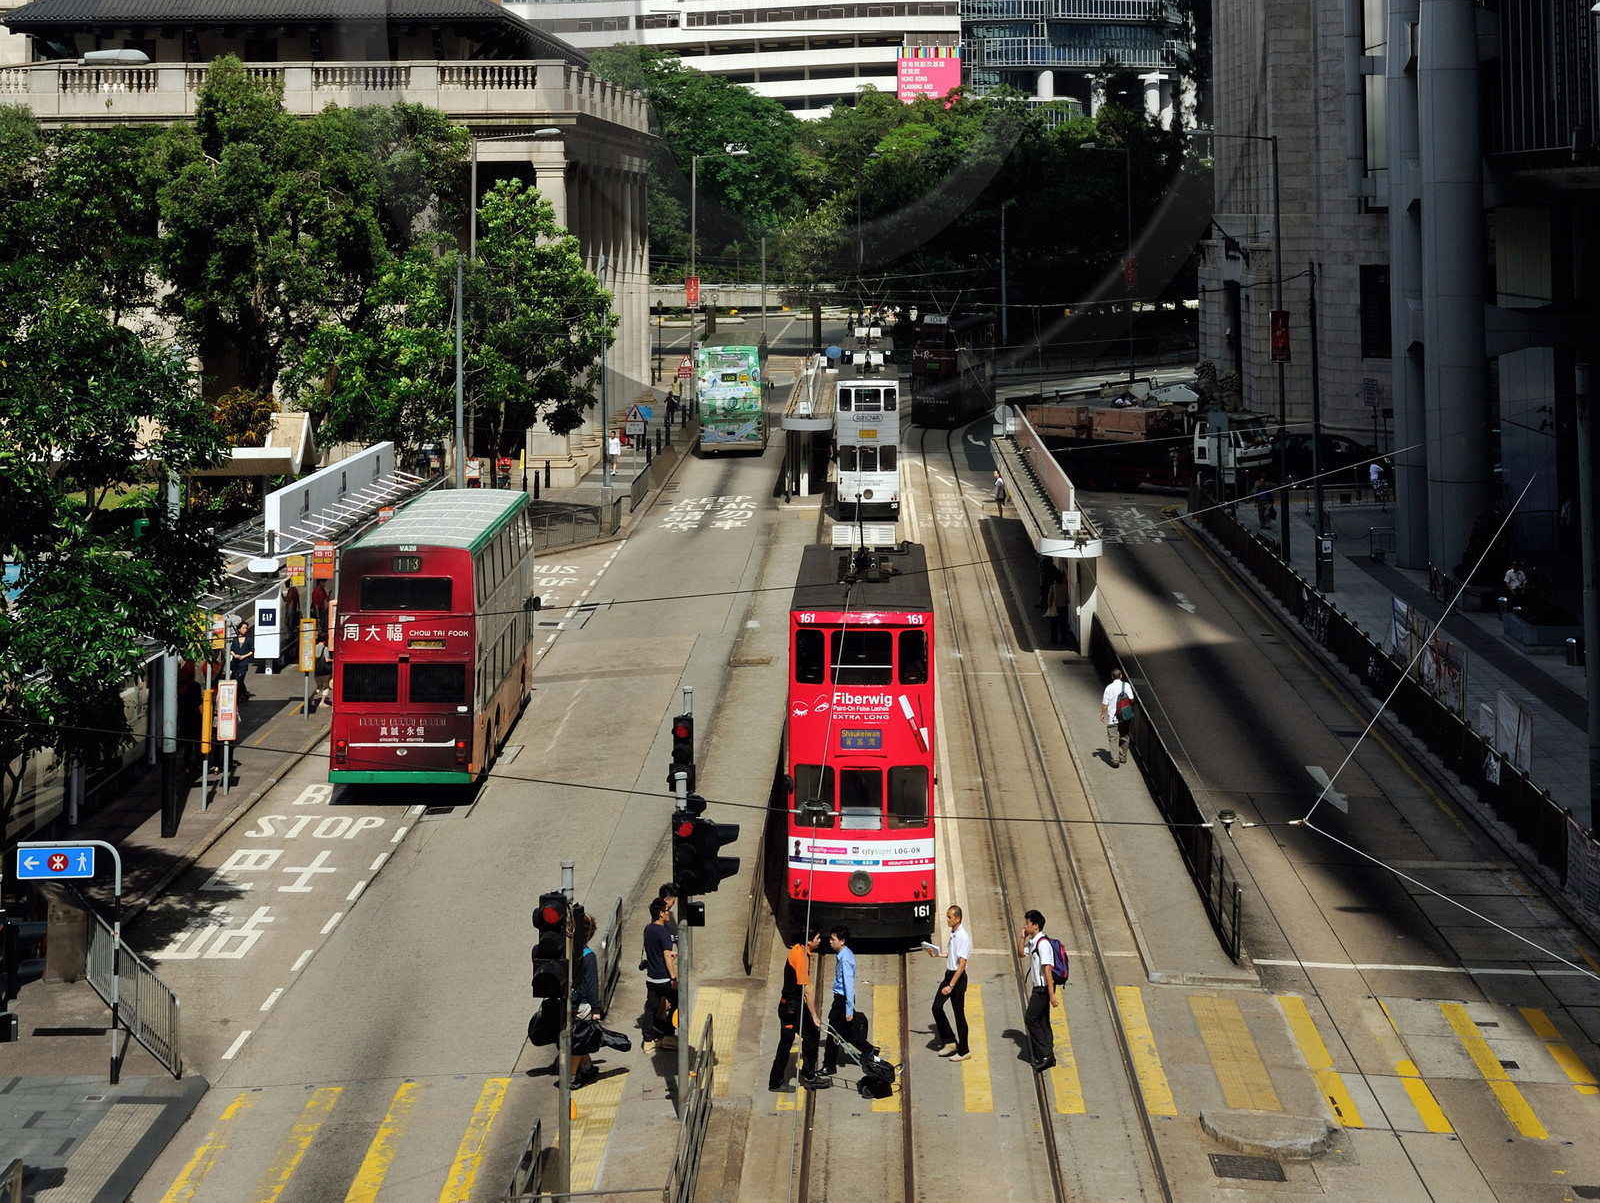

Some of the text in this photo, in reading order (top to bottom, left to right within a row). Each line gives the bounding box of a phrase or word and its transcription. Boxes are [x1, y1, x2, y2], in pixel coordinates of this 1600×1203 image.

[680, 495, 752, 506] KEEP
[669, 502, 757, 511] CLEAR
[398, 558, 419, 570] 113
[262, 613, 273, 622] GAP
[800, 613, 815, 624] 161
[907, 614, 922, 625] 161
[343, 623, 403, 641] 周大福
[833, 692, 892, 707] Fiberwig
[841, 730, 881, 738] Shaukeiwan
[245, 815, 385, 839] STOP
[894, 847, 921, 855] LOG-ON
[199, 849, 337, 893] 巴士
[914, 905, 930, 918] 161
